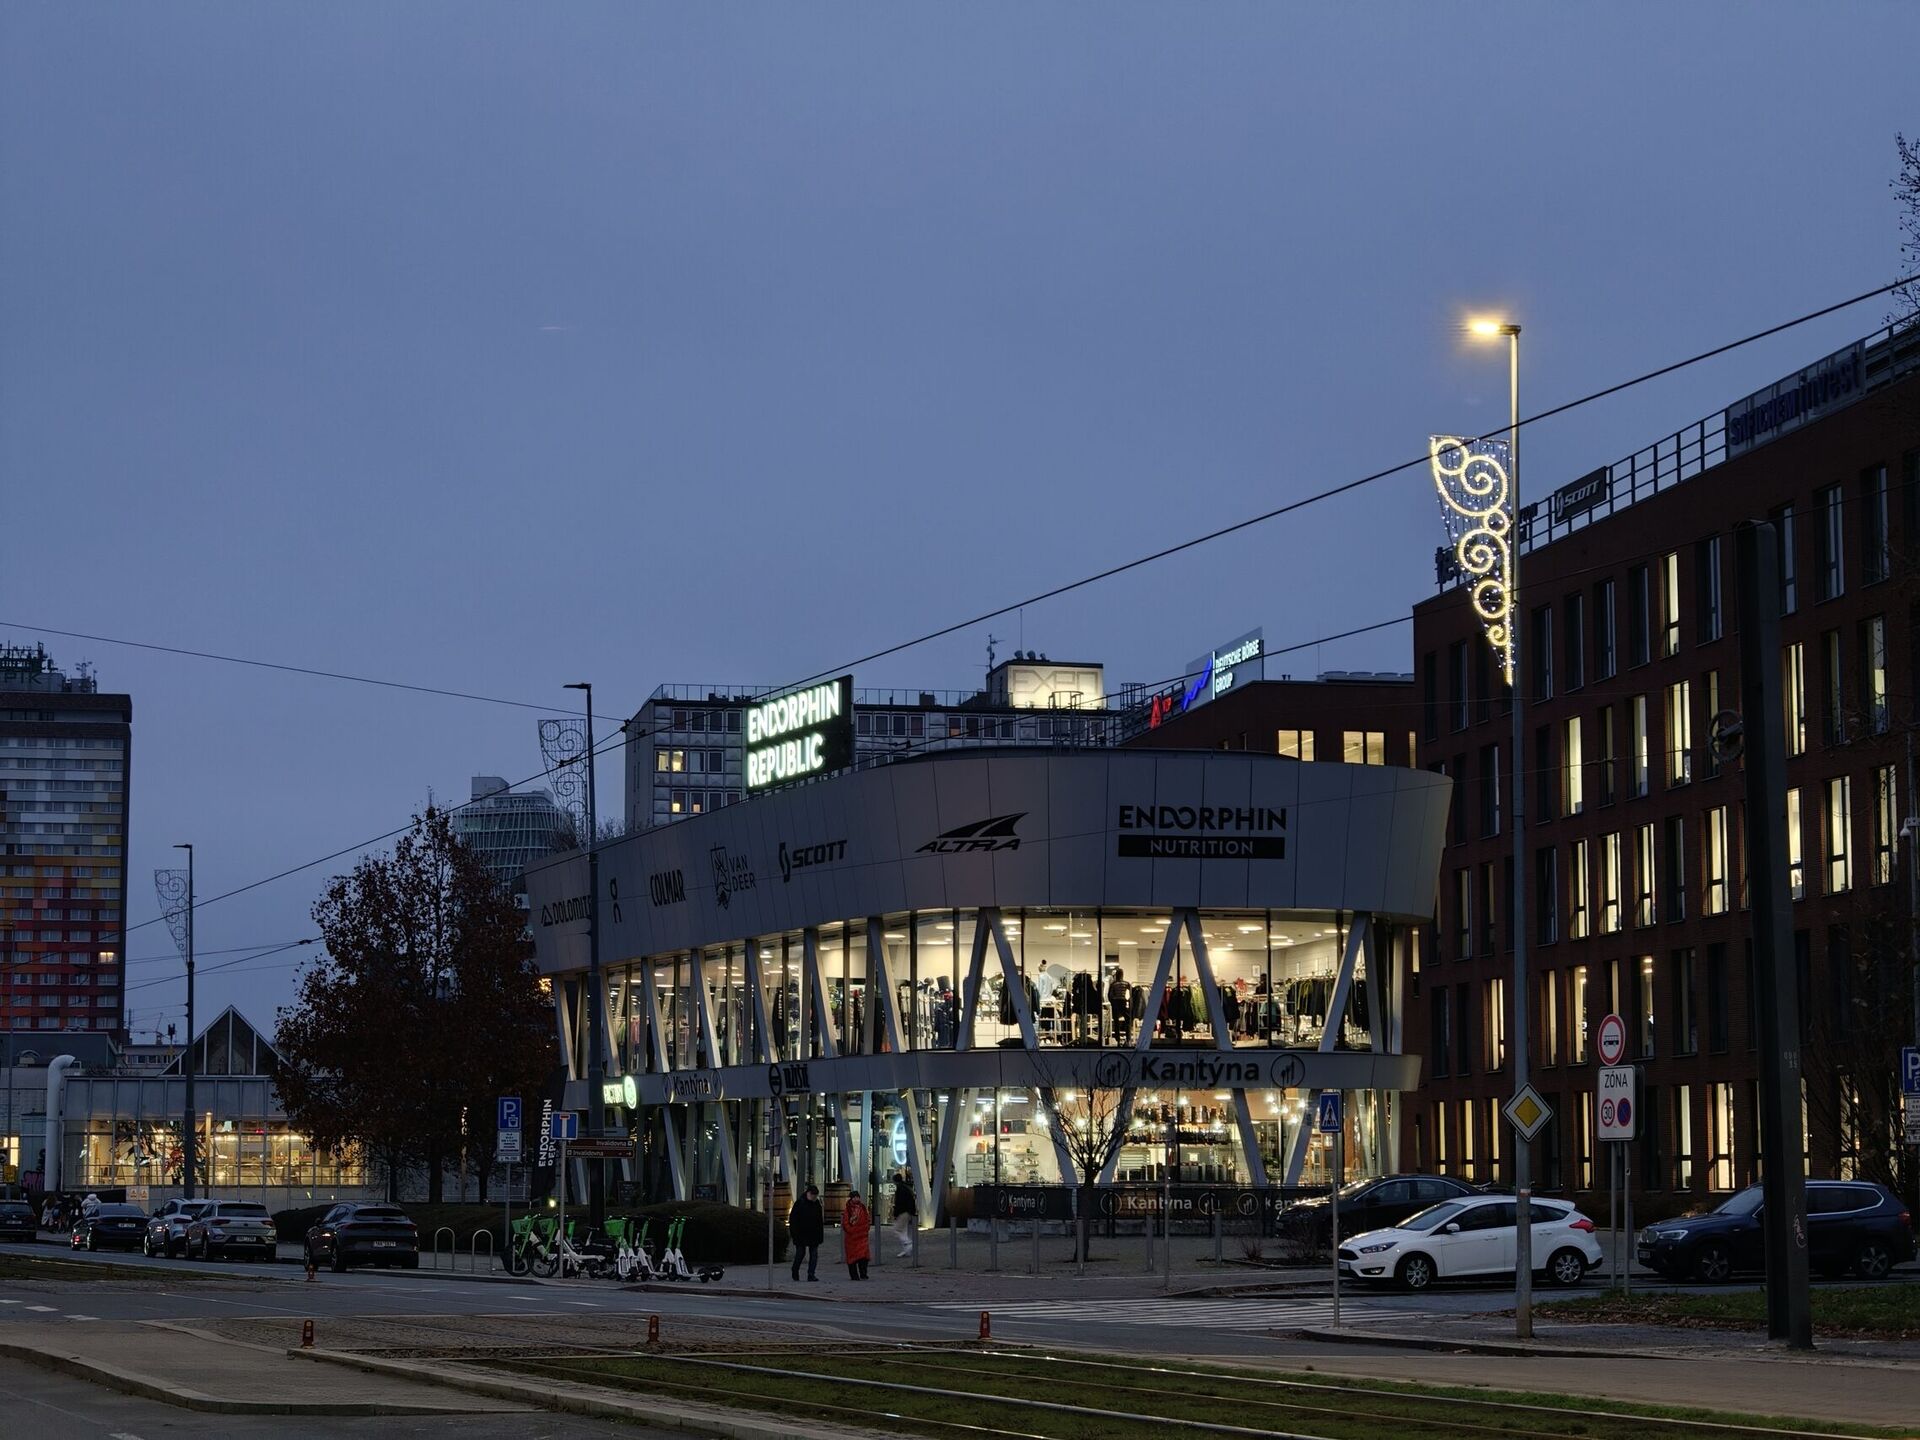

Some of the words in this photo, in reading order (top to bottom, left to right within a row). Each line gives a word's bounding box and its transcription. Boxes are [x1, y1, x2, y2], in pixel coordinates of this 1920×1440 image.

[1564, 479, 1601, 508] SCOTT
[1215, 672, 1233, 693] GROUP
[747, 681, 840, 743] ENDORPHIN
[747, 733, 824, 787] REPUBLIC
[1119, 805, 1287, 831] ENDORPHIN
[792, 840, 847, 869] SCOTT
[915, 839, 1021, 853] ALTRA
[1150, 839, 1254, 855] NUTRITION
[729, 854, 748, 873] VAN
[650, 869, 686, 907] COLMAR
[732, 872, 756, 892] DEER
[1141, 1056, 1260, 1087] Kantýna
[1604, 1071, 1628, 1088] ZÓNA
[673, 1073, 711, 1099] Kantýna
[1604, 1106, 1612, 1120] 30
[538, 1099, 553, 1167] ENDORPHIN
[1008, 1194, 1036, 1211] Kantýna
